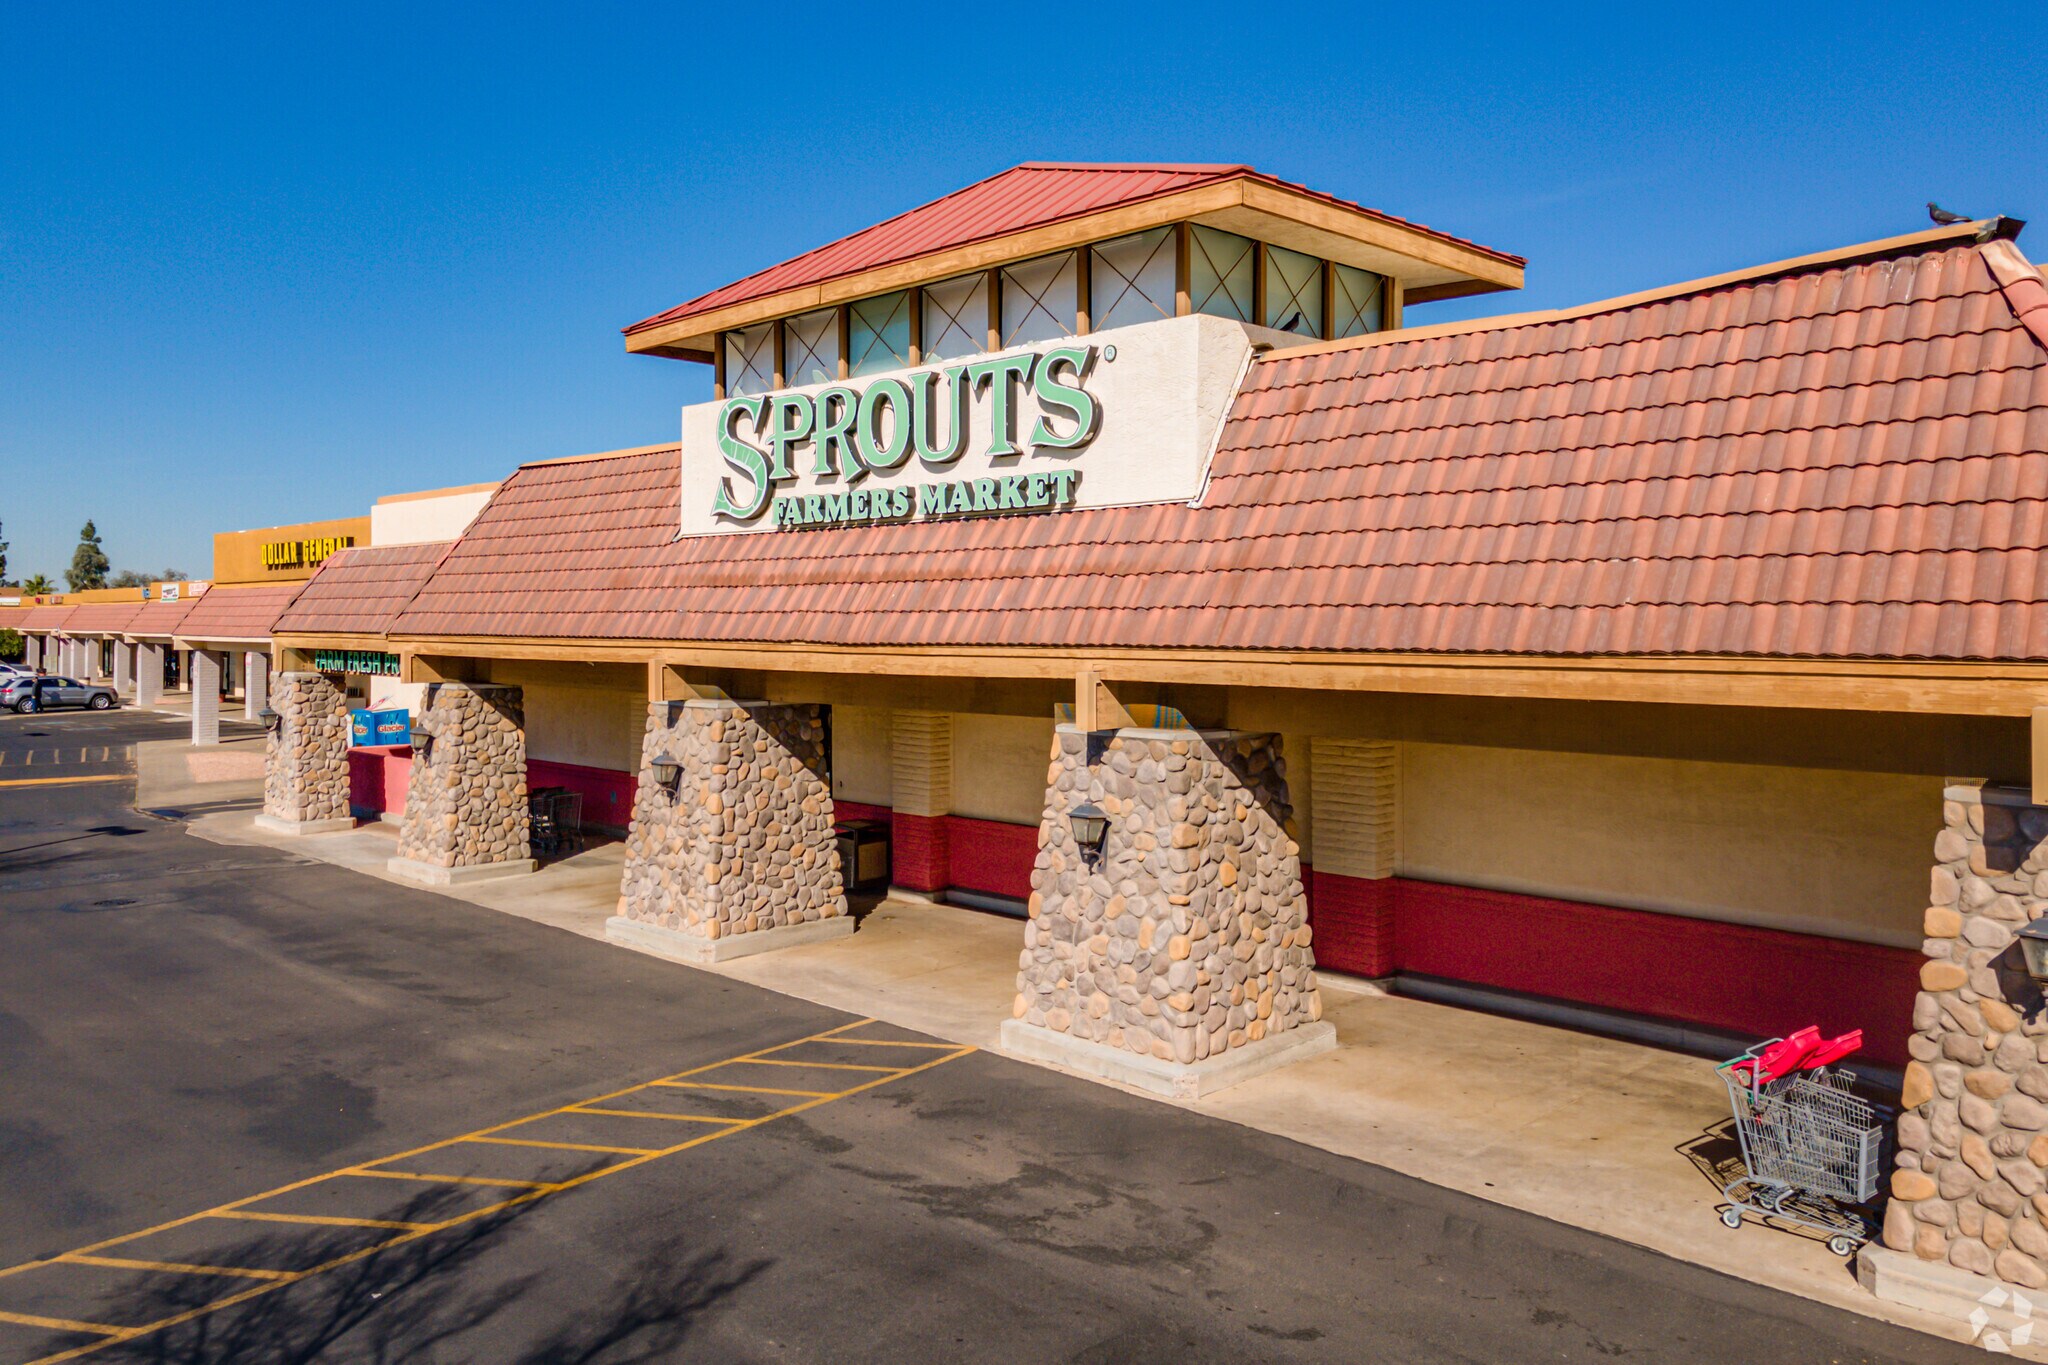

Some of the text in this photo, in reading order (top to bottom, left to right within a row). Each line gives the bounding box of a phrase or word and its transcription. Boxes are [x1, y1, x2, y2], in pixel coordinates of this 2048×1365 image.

[711, 344, 1098, 519] SPROUTS
[771, 468, 1076, 525] FARMERS MARKET
[261, 541, 298, 565] DOLLAR
[314, 649, 400, 676] FARM FRESH PR
[377, 723, 405, 733] Glacier
